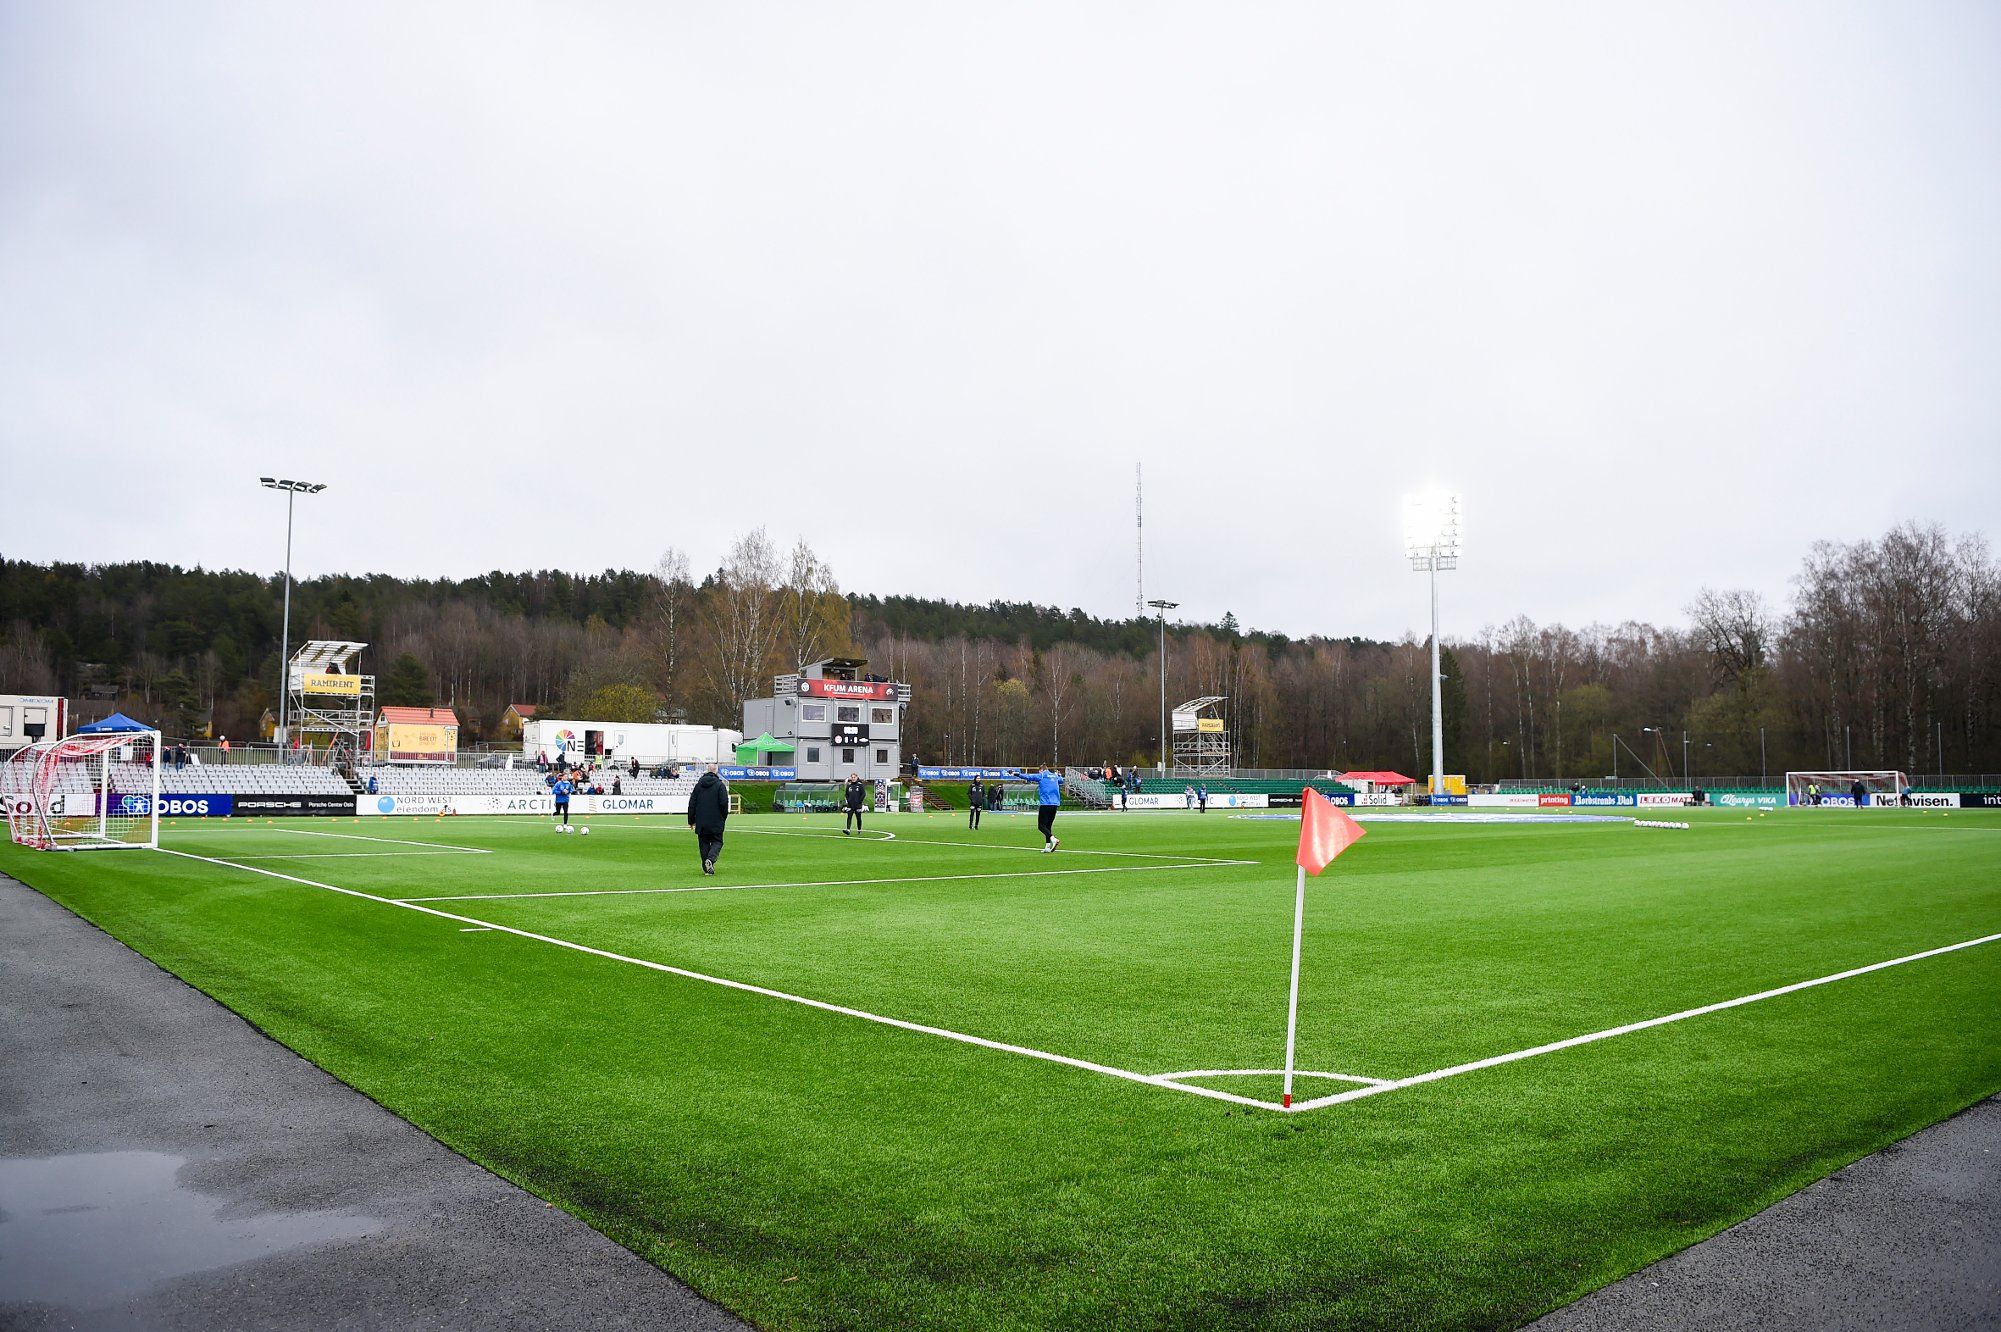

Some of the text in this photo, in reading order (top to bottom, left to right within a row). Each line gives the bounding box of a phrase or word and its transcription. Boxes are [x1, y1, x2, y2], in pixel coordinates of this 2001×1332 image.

[311, 679, 354, 689] RAMIRENT
[823, 684, 846, 693] KFUM
[847, 685, 874, 694] ARENA
[396, 796, 453, 804] NORD WEST
[507, 799, 556, 810] ARCTI
[602, 799, 654, 810] GLOMAR
[1128, 796, 1159, 806] GLOMAR
[1330, 796, 1349, 805] OBOS
[1369, 794, 1387, 805] Solid
[1540, 795, 1569, 805] printing
[1574, 795, 1634, 806] Nordstrands Blad
[1820, 796, 1855, 806] OBOS
[156, 800, 209, 814] OBOS
[396, 805, 439, 813] eiendom
